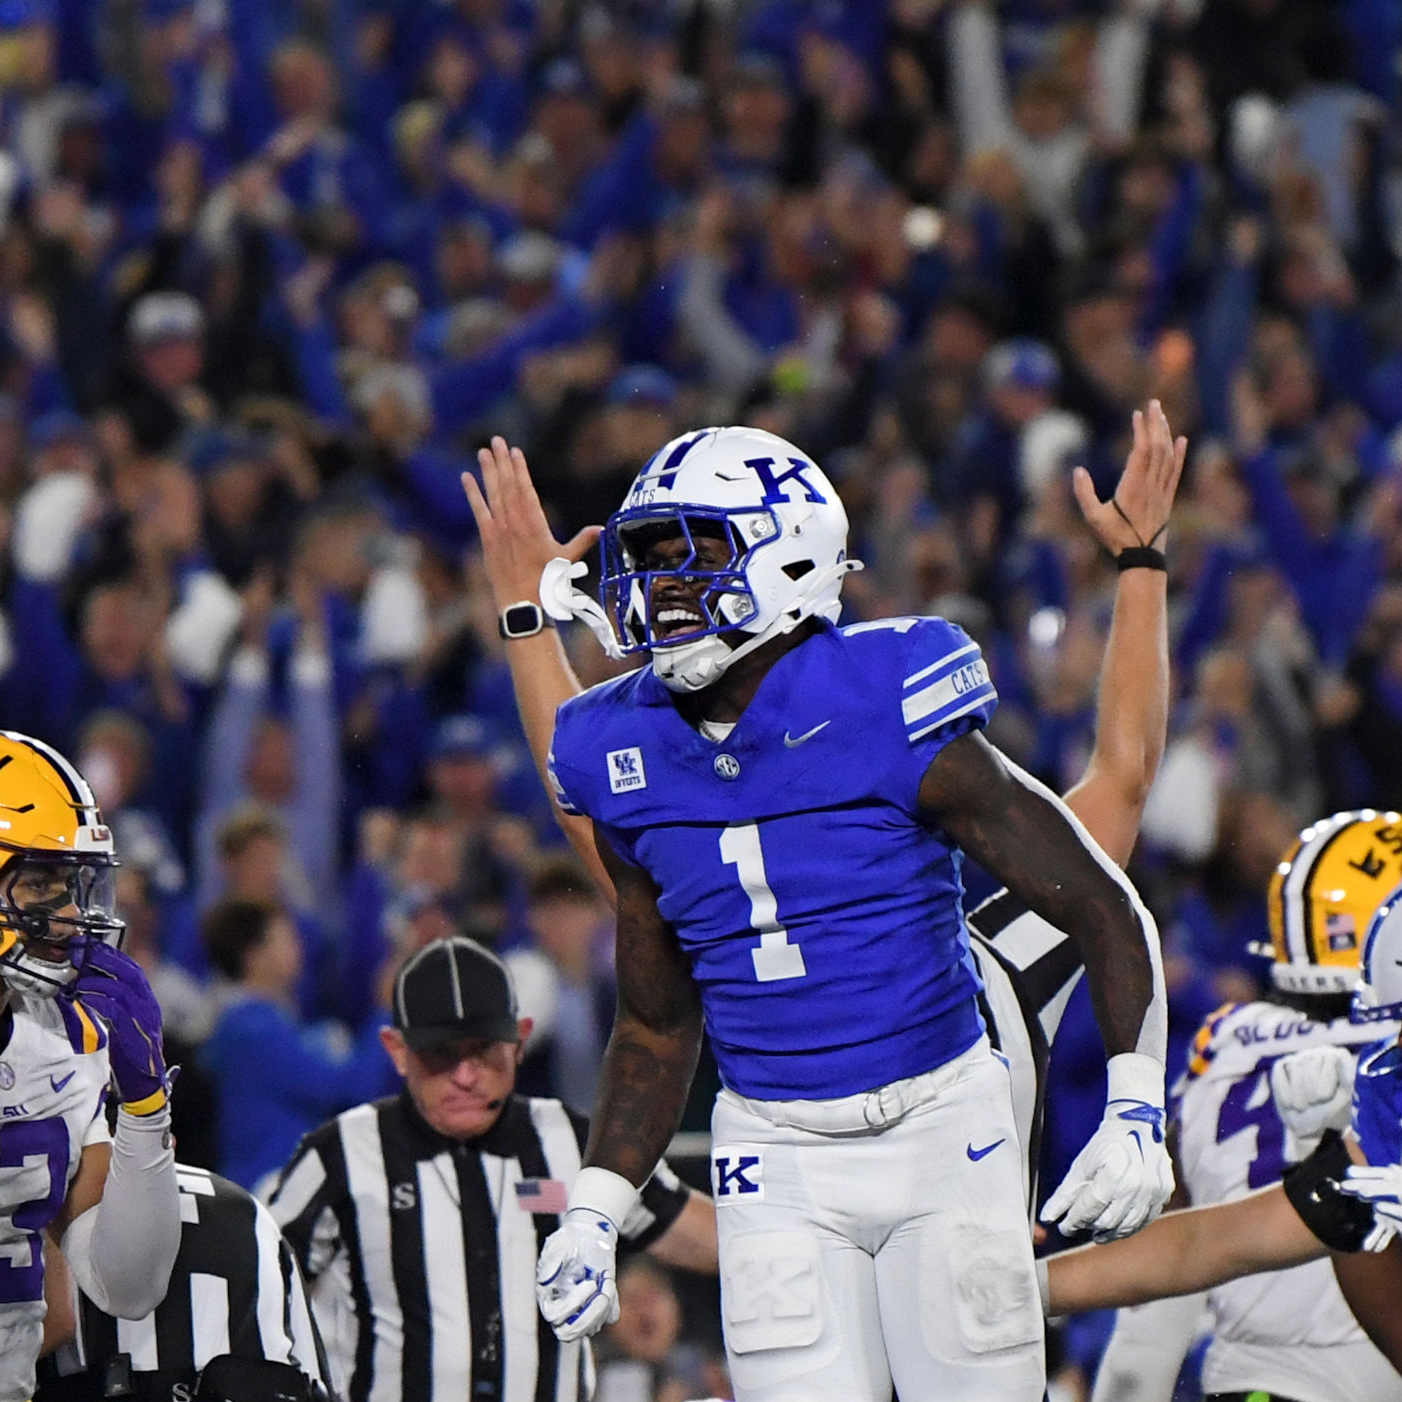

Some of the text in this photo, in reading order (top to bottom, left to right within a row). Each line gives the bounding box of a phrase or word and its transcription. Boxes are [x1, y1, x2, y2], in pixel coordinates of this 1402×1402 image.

[743, 457, 828, 506] K
[950, 662, 985, 695] CATS
[715, 756, 740, 778] SEC
[718, 822, 807, 982] 1
[715, 1156, 759, 1196] K
[392, 1182, 416, 1210] S
